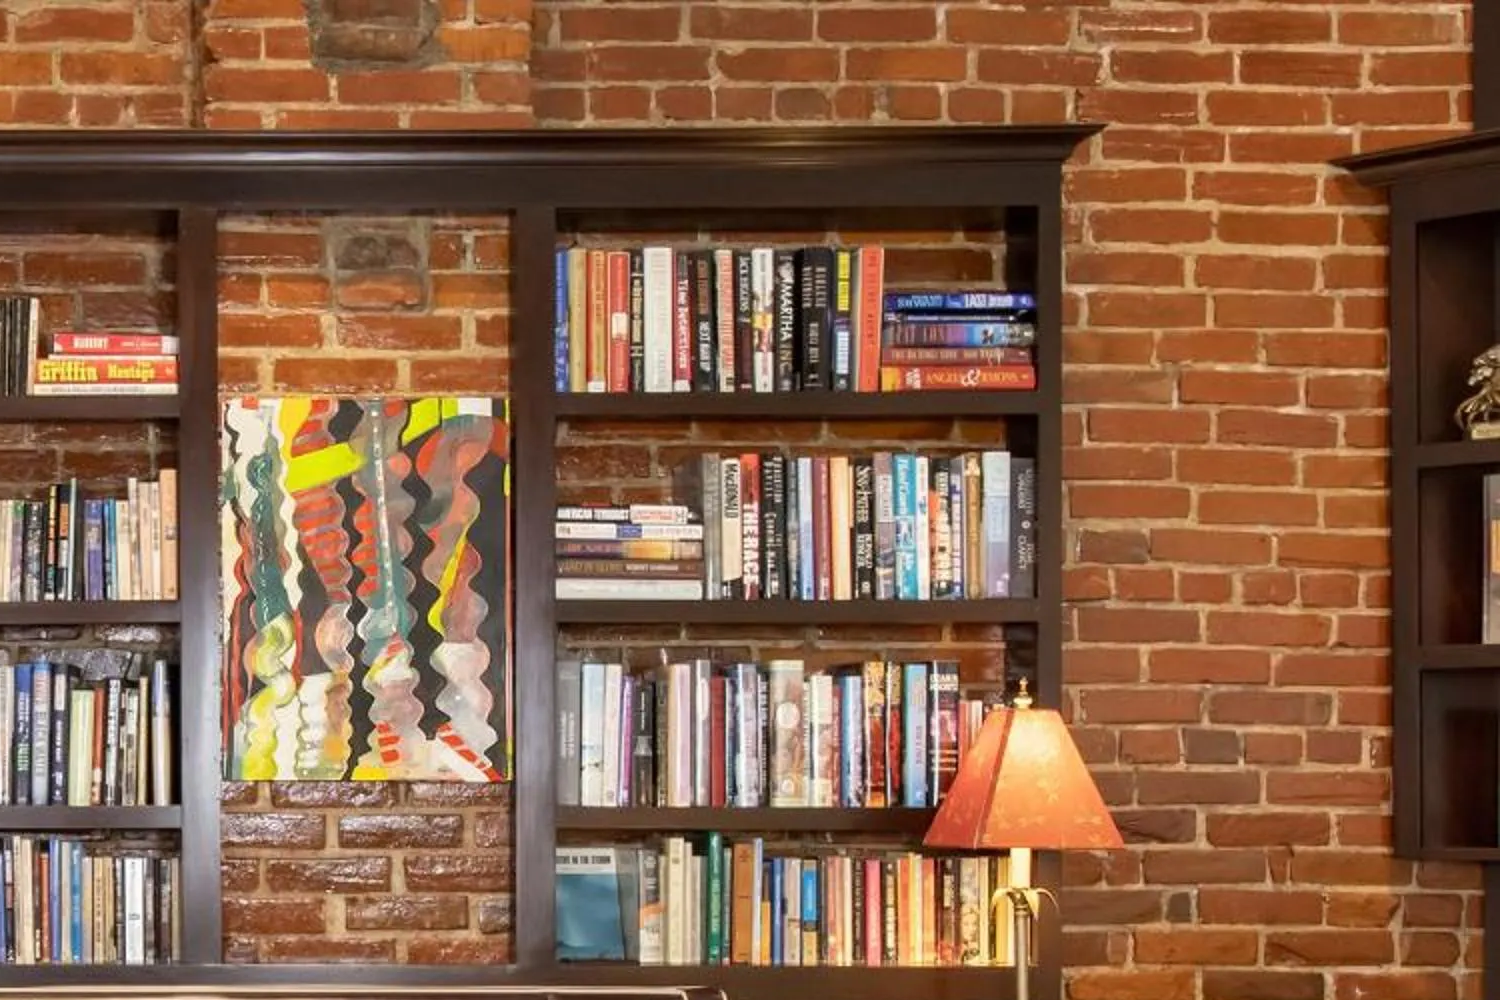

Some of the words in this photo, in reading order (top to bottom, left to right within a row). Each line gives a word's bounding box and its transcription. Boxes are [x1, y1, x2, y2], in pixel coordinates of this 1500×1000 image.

[780, 284, 793, 341] MARTHA
[724, 463, 739, 519] MacDONALD
[743, 502, 759, 536] THE
[743, 537, 759, 585] RACE
